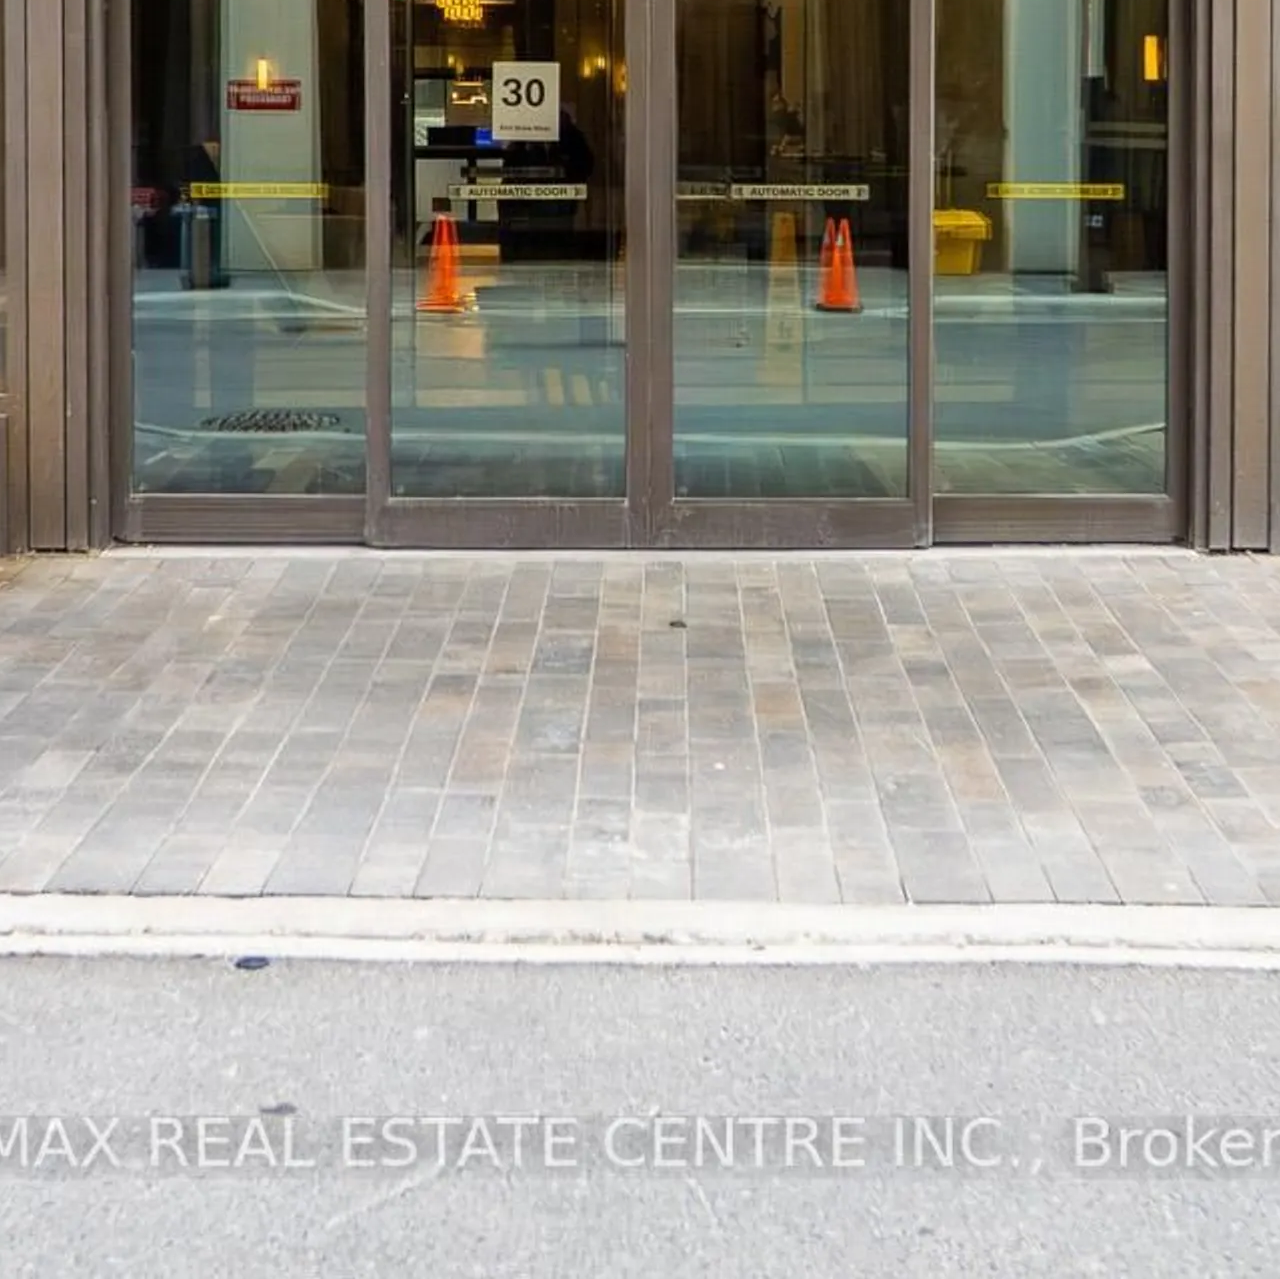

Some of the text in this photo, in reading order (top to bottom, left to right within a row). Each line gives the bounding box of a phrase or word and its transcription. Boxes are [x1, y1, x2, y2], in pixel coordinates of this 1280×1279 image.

[501, 77, 546, 108] 30
[468, 186, 568, 197] AUTOMATIC DOOR
[749, 186, 850, 197] AUTOMATIC DOOR
